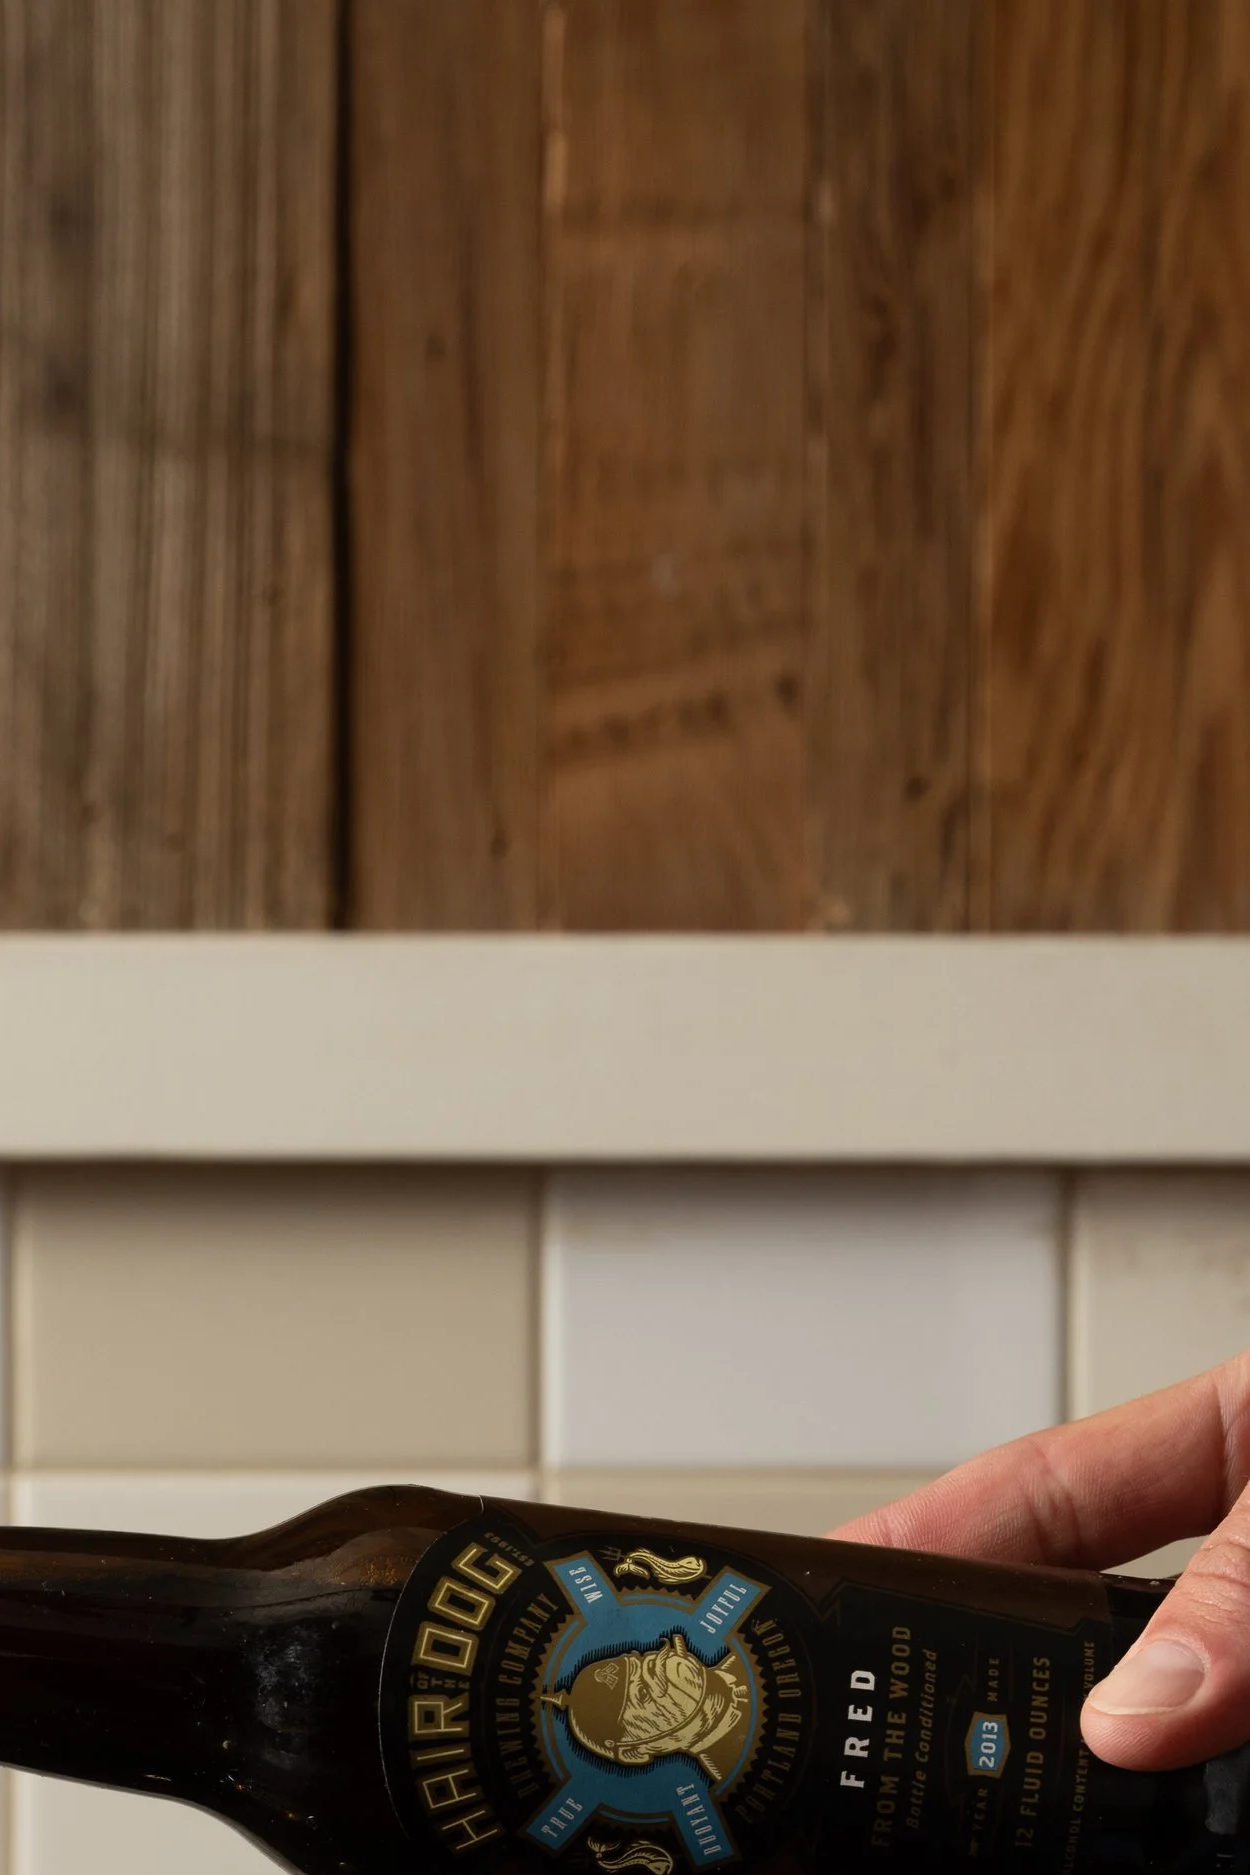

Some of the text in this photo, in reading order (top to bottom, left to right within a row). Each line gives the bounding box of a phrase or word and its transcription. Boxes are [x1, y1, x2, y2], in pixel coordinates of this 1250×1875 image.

[568, 1566, 604, 1604] WISE
[699, 1583, 748, 1634] JOYFUL
[408, 1541, 523, 1859] HAIR OF THE DOG
[495, 1592, 559, 1800] BREWING COMPANY
[733, 1618, 803, 1825] PORTLAND OREGON
[839, 1669, 876, 1789] FRED
[870, 1626, 911, 1848] FROM THE WOOD
[905, 1648, 938, 1830] Bottle Conditioned
[971, 1658, 1000, 1831] YEAR 2013 MADE
[1014, 1656, 1051, 1848] 12 FLUID OUNCES
[1072, 1749, 1090, 1812] CONTENT
[1083, 1640, 1095, 1690] VOLUME
[540, 1797, 584, 1838] TRUE
[675, 1783, 723, 1856] BUOYANT
